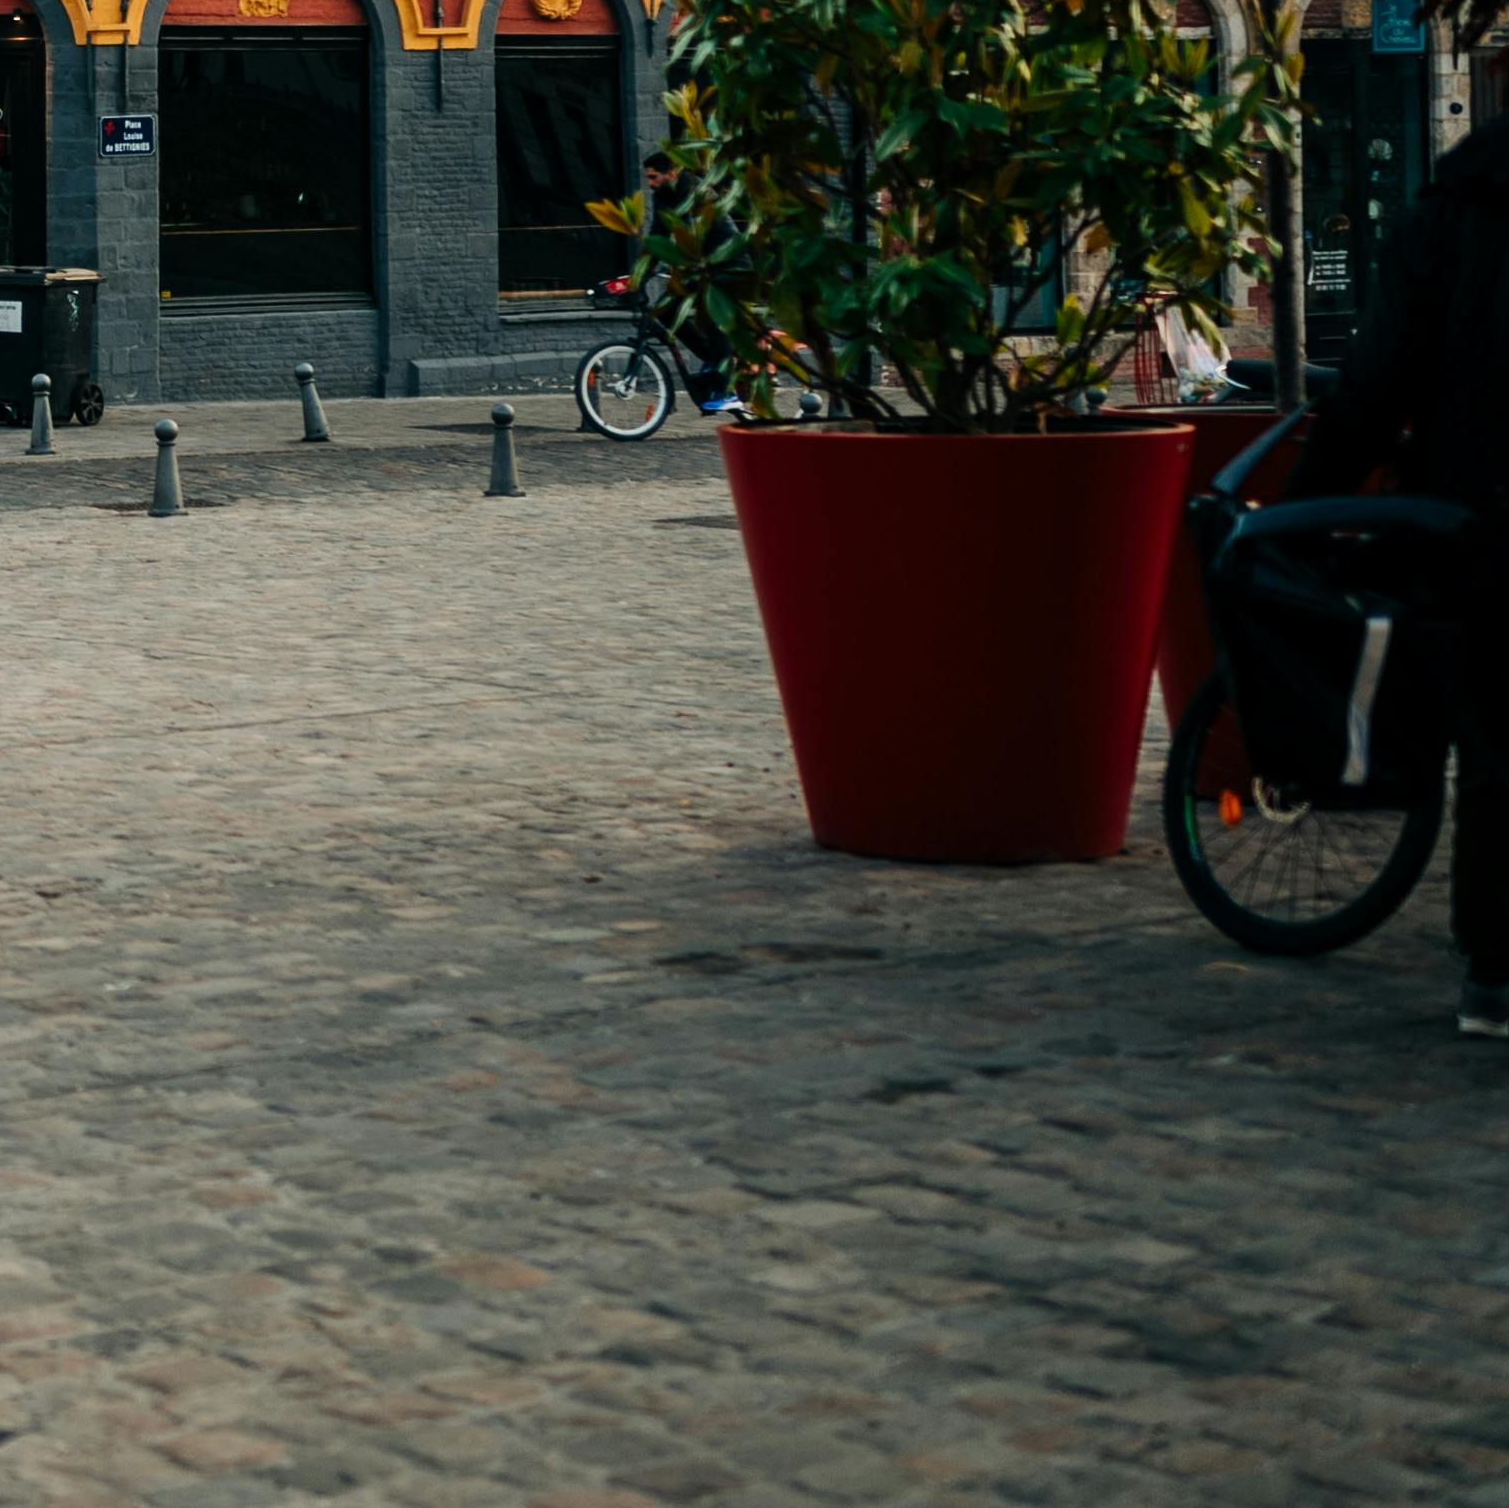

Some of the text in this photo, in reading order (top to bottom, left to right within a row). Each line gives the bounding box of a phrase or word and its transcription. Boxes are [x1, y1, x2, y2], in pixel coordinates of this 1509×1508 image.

[124, 120, 142, 129] Place
[123, 131, 144, 141] Louise
[105, 143, 114, 153] de
